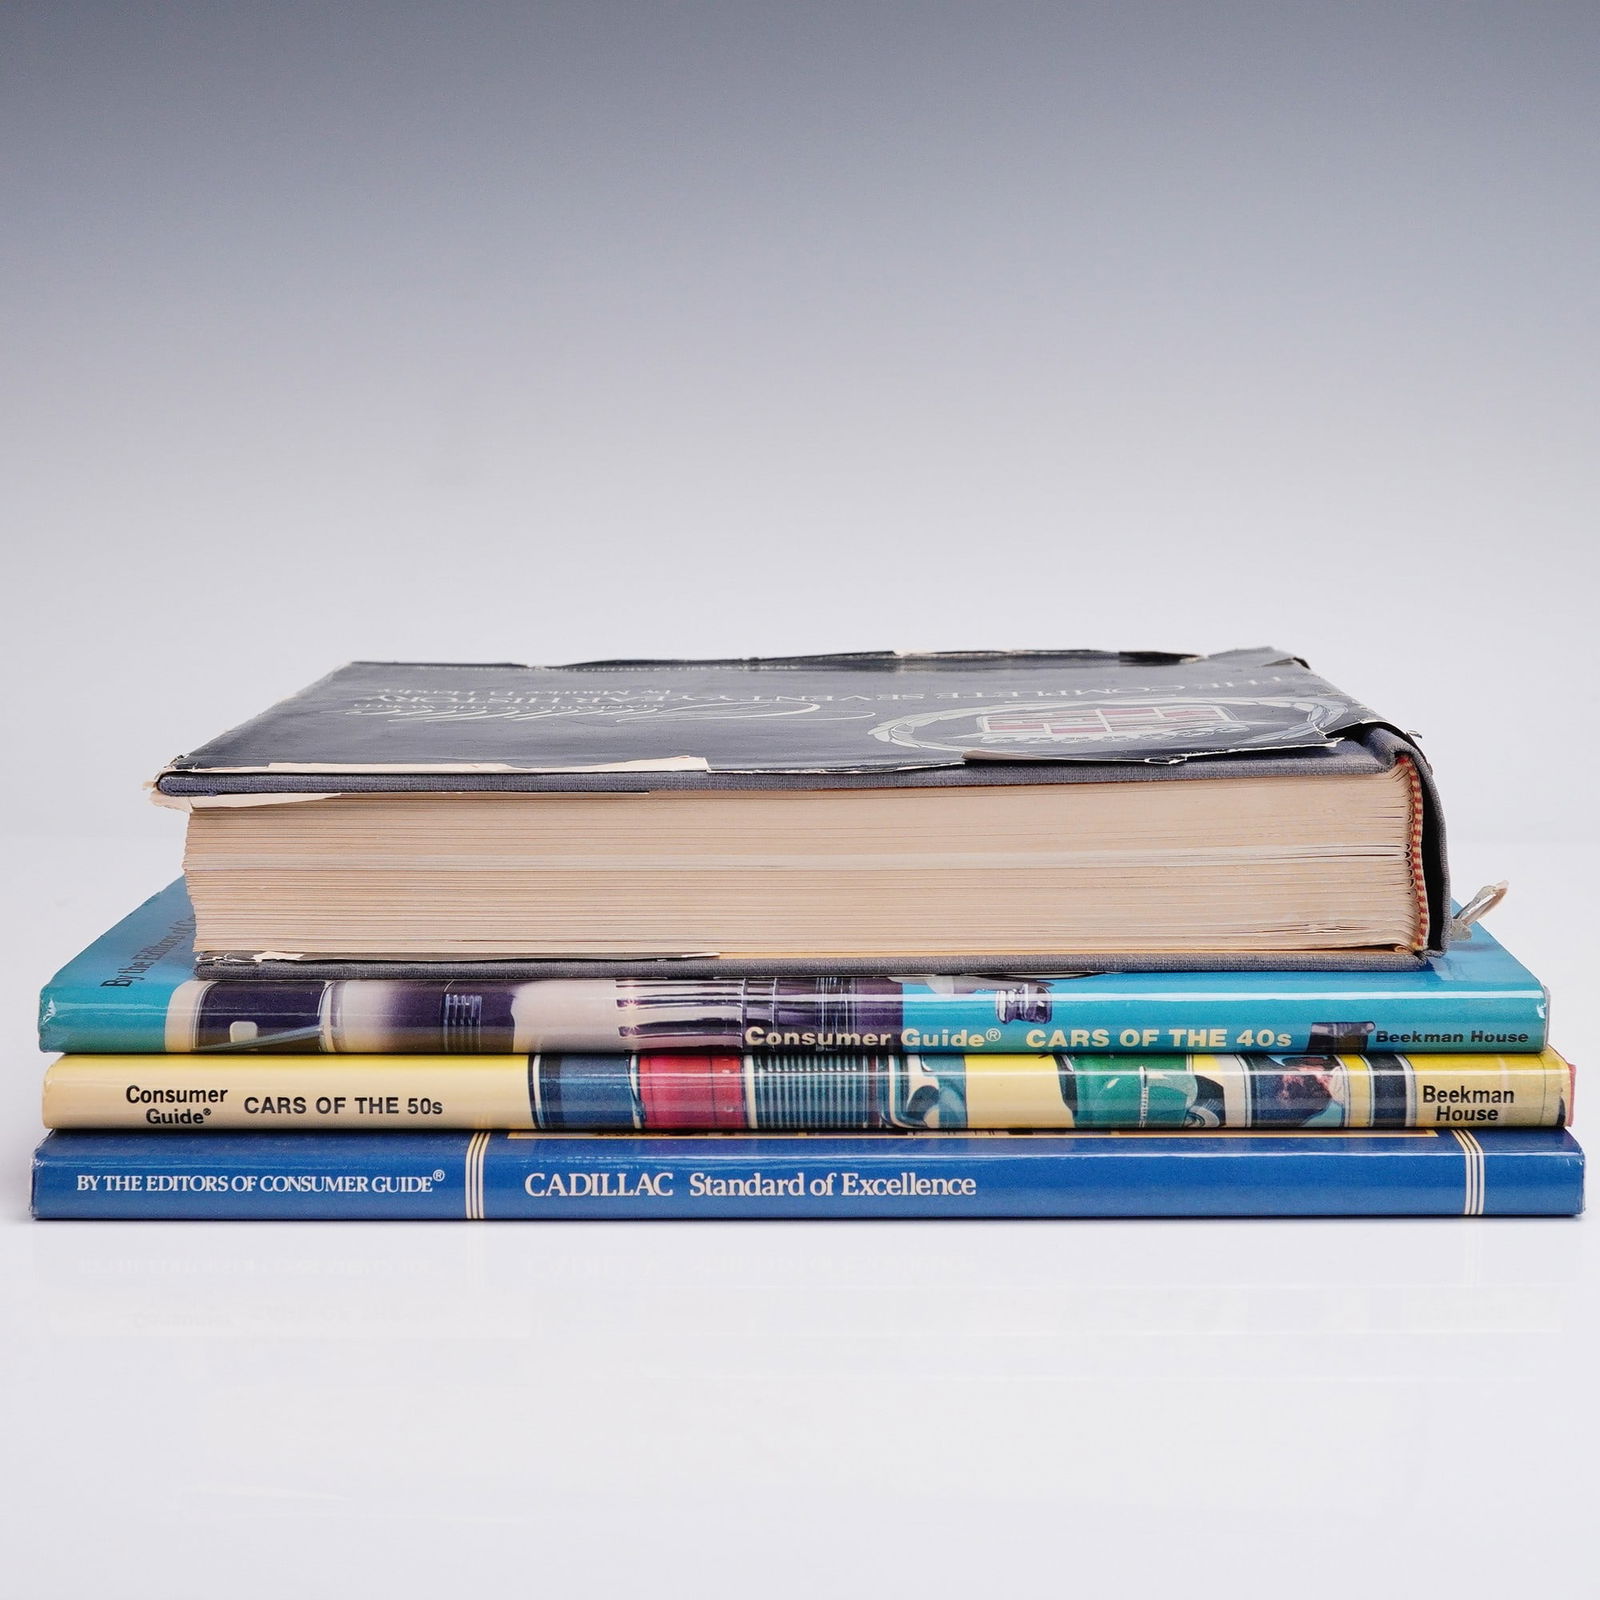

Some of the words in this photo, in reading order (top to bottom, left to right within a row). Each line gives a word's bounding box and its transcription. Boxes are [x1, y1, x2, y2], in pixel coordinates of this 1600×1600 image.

[365, 694, 562, 705] HISTORY
[935, 684, 1186, 699] COMPLETE
[131, 935, 185, 961] Editors
[117, 961, 155, 975] the
[100, 974, 145, 987] By
[744, 1026, 892, 1048] Consumer
[1025, 1029, 1110, 1049] CARS
[1119, 1029, 1160, 1048] OF
[1168, 1028, 1228, 1048] THE
[1236, 1029, 1293, 1048] 40s
[1376, 1029, 1465, 1045] Beekman
[1469, 1029, 1530, 1044] House
[125, 1083, 229, 1105] Consumer
[1422, 1084, 1516, 1105] Beekman
[243, 1096, 308, 1116] CARS
[315, 1096, 347, 1115] OF
[354, 1096, 400, 1115] THE
[406, 1097, 444, 1115] 50s
[1435, 1104, 1499, 1122] House
[76, 1174, 101, 1193] BY
[102, 1175, 143, 1193] THE
[145, 1175, 229, 1193] EDITORS
[230, 1175, 258, 1193] OF
[258, 1175, 371, 1194] CONSUMER
[524, 1172, 675, 1198] CADILLAC
[689, 1172, 805, 1197] Standard
[808, 1172, 838, 1197] of
[840, 1172, 977, 1198] Excellence
